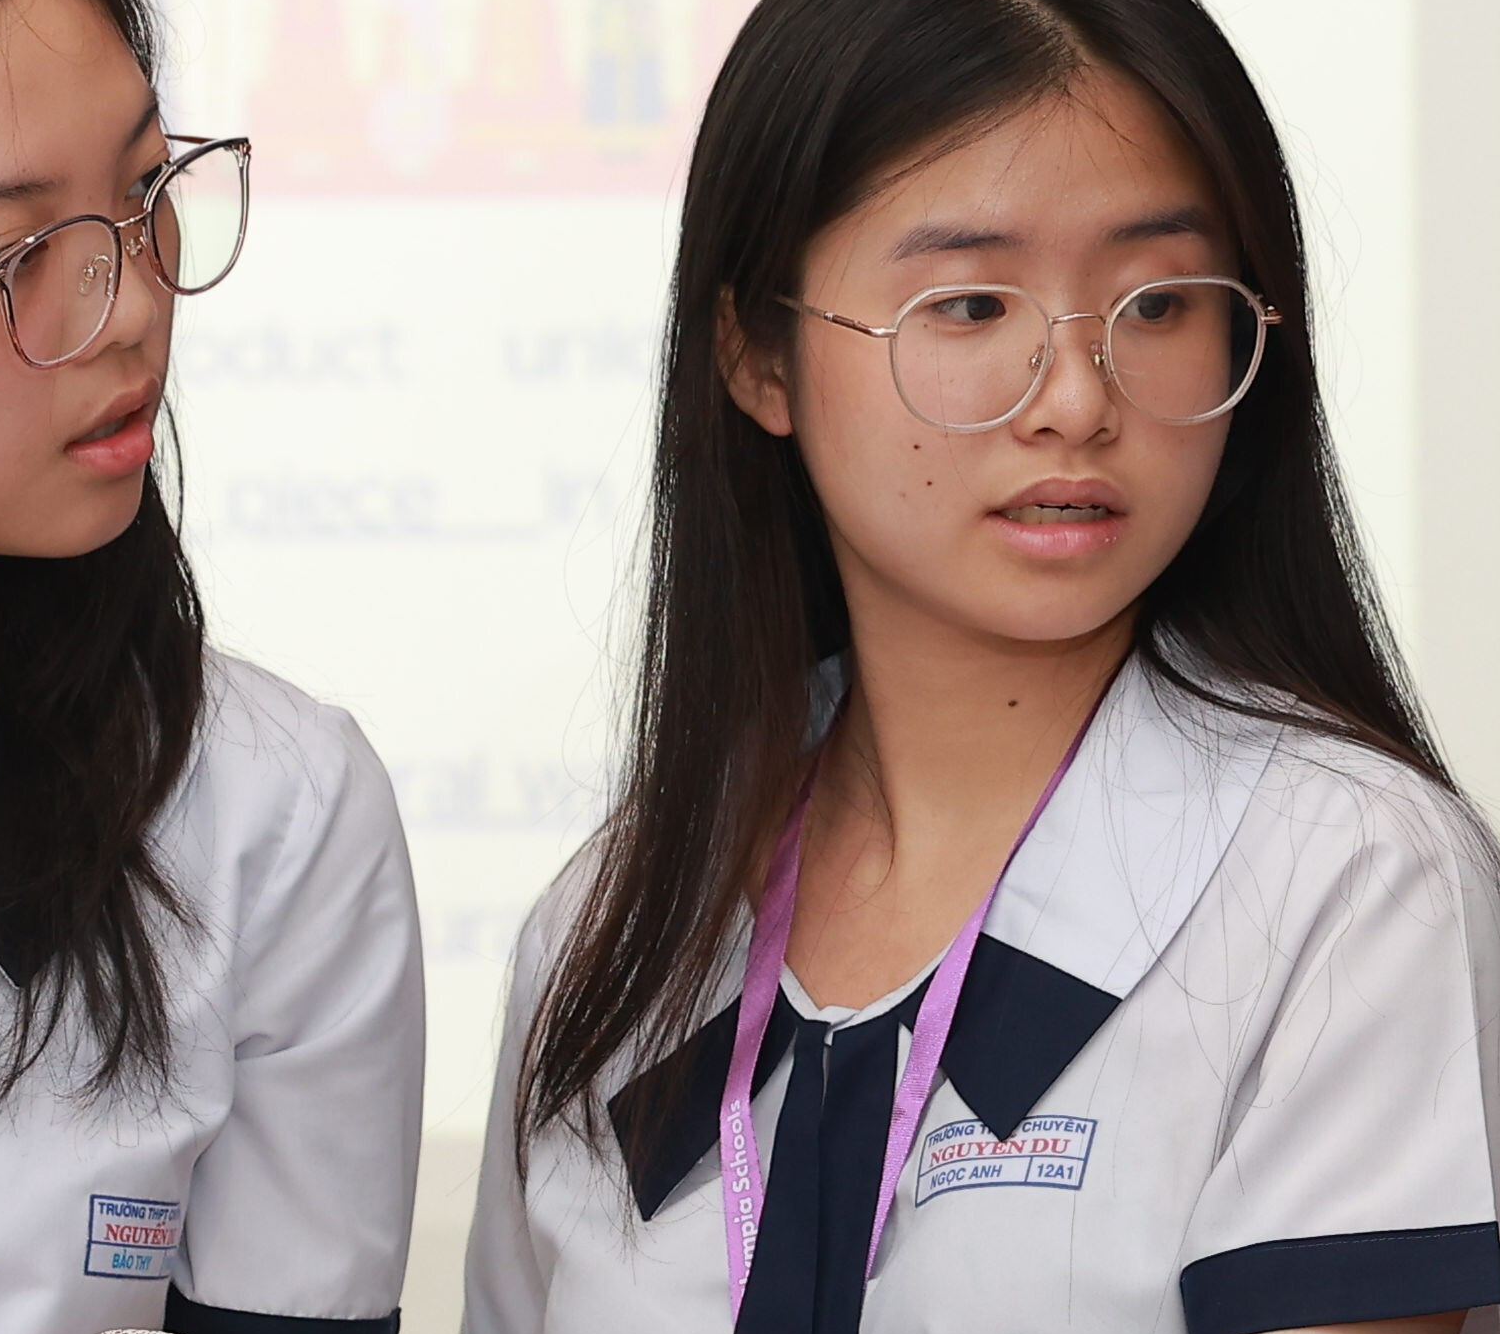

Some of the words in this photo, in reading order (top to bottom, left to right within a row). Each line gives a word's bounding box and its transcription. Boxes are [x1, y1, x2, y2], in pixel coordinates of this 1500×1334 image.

[172, 321, 407, 383] oduct
[1022, 1119, 1087, 1134] CHUYÊN
[727, 1099, 751, 1194] Schools
[1030, 1138, 1071, 1155] DU
[930, 1167, 966, 1191] NGỌC
[969, 1164, 1003, 1179] ANH
[1037, 1163, 1075, 1180] 12A1
